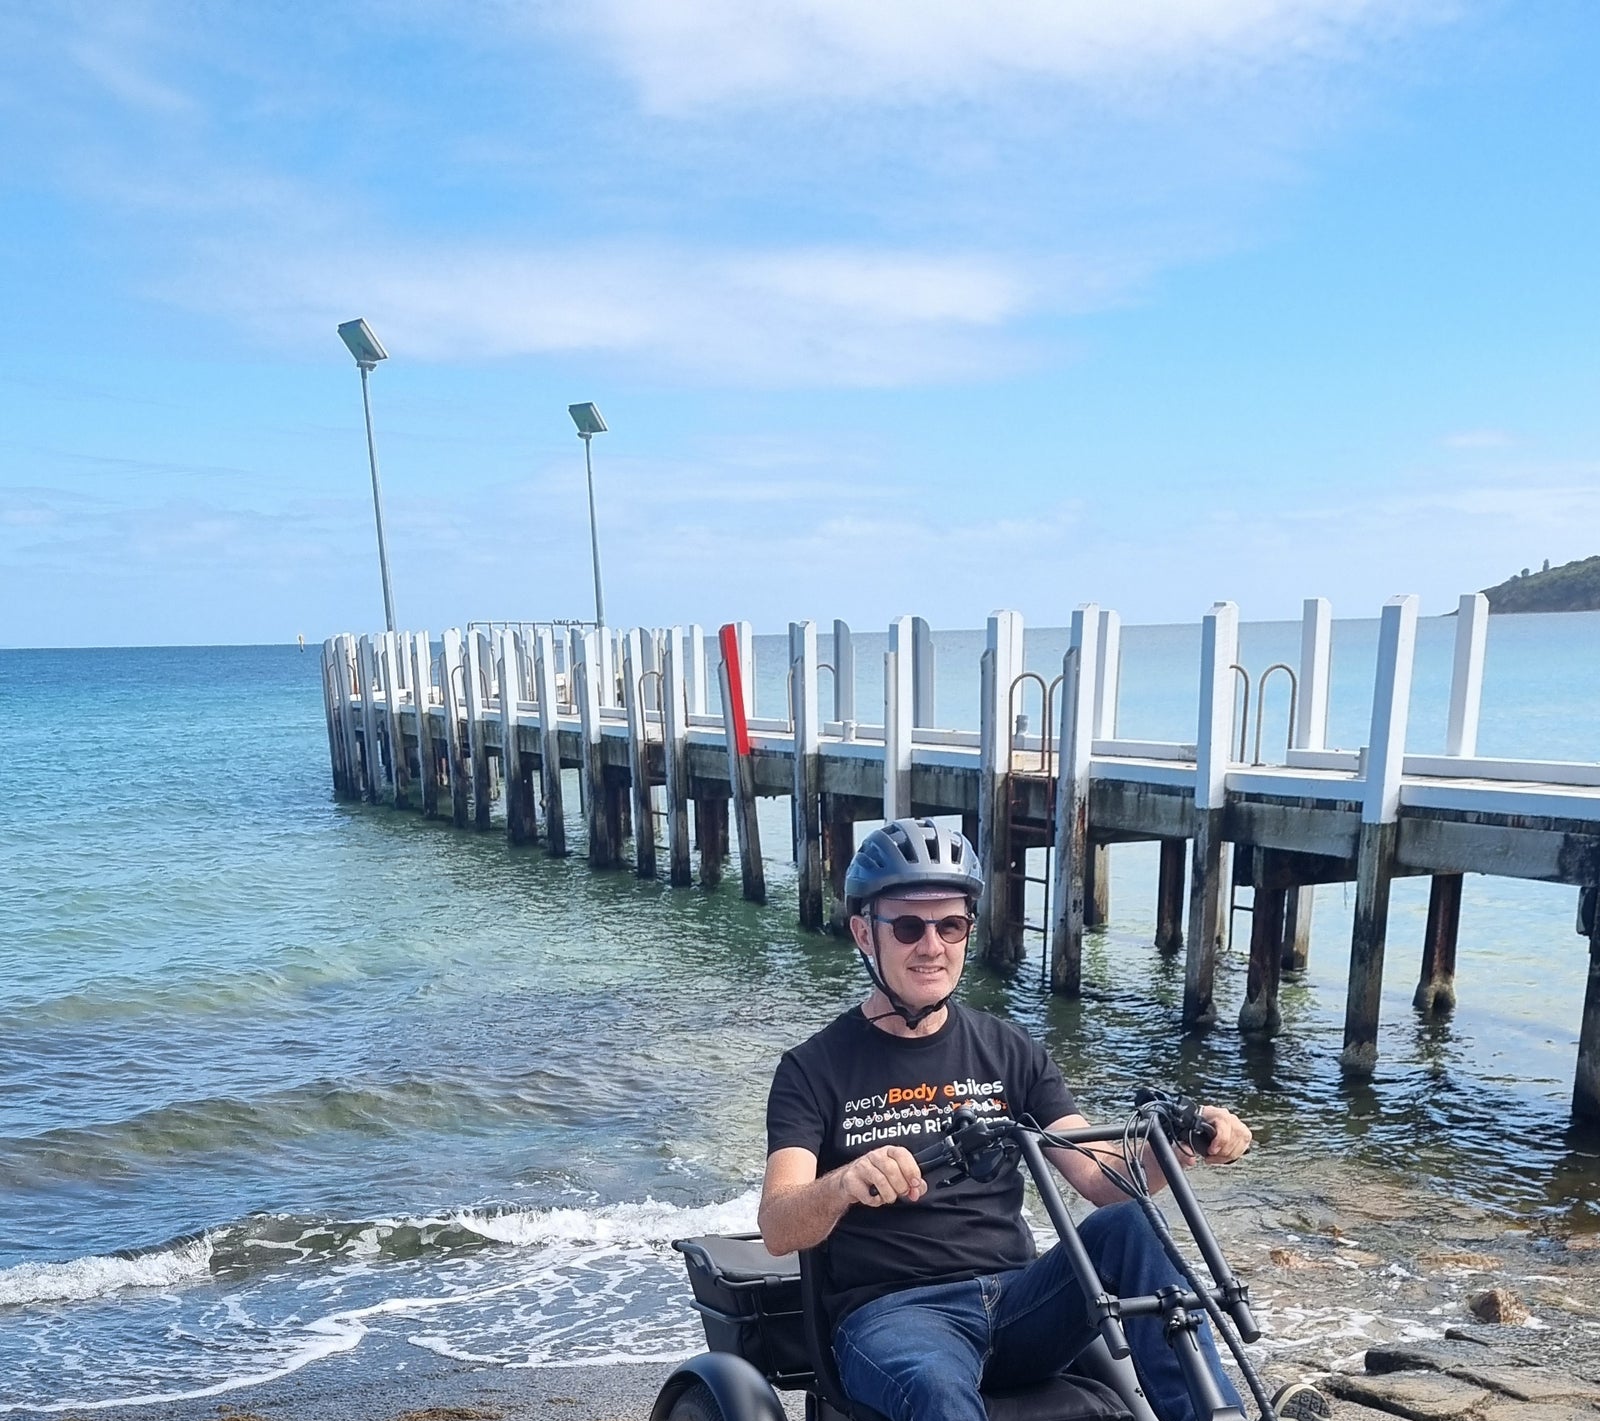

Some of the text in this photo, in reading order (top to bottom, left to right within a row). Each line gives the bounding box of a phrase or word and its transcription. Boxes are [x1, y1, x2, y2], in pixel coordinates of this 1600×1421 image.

[845, 1078, 1004, 1113] everyBody ebikes
[845, 1122, 922, 1147] Inclusive
